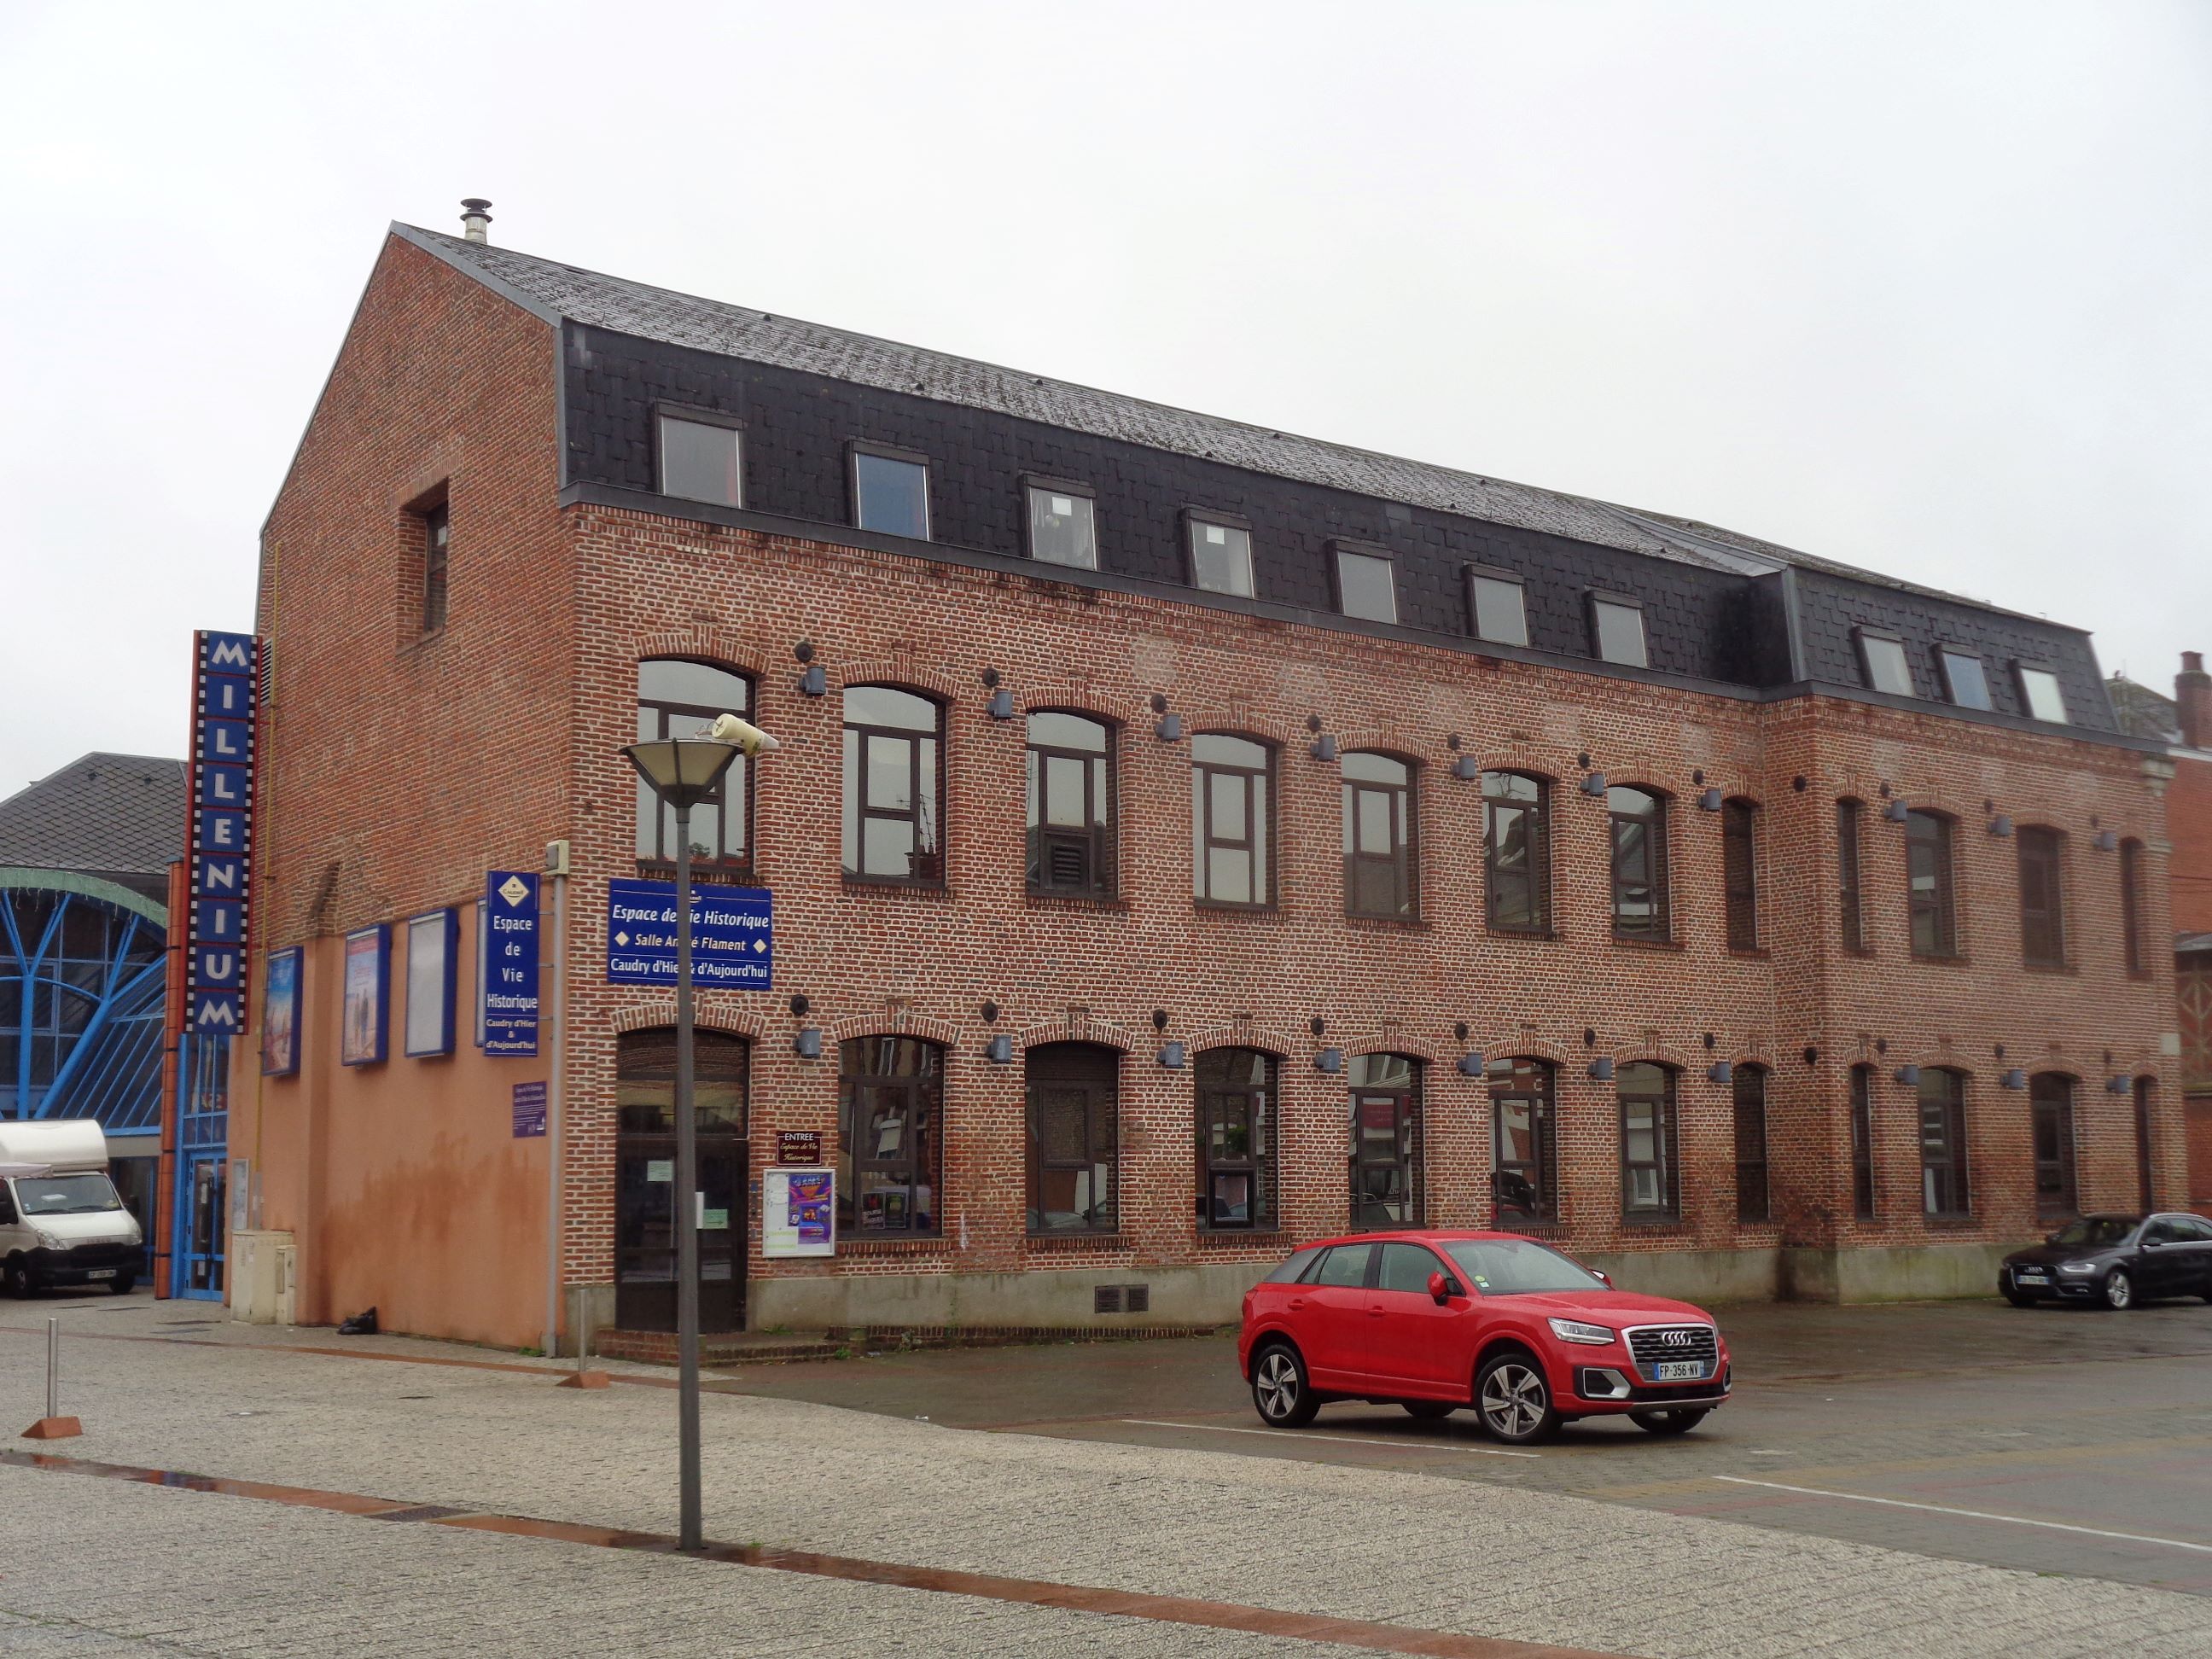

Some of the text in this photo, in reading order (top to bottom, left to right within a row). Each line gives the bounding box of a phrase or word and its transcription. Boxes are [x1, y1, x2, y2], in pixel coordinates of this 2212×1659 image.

[197, 639, 247, 1026] MILLENIUM
[493, 915, 533, 934] Espace
[613, 905, 658, 923] Espace
[661, 908, 678, 923] de
[704, 911, 769, 929] Historique
[505, 941, 521, 957] de
[635, 934, 746, 951] Salle Ané Flament
[502, 967, 524, 982] Vie
[611, 958, 650, 975] Caudry
[653, 959, 679, 974] d'Hie
[697, 963, 767, 979] d'Aujourd'hui
[486, 993, 538, 1012] Historique
[486, 1019, 537, 1028] Caudry d'Hier
[508, 1030, 515, 1039] &
[486, 1040, 536, 1051] d'Aujourd'hui
[784, 1132, 814, 1141] ENTREE
[780, 1143, 800, 1152] Espace
[783, 1153, 815, 1163] Historique
[1659, 1364, 1699, 1377] FP-356-NV
